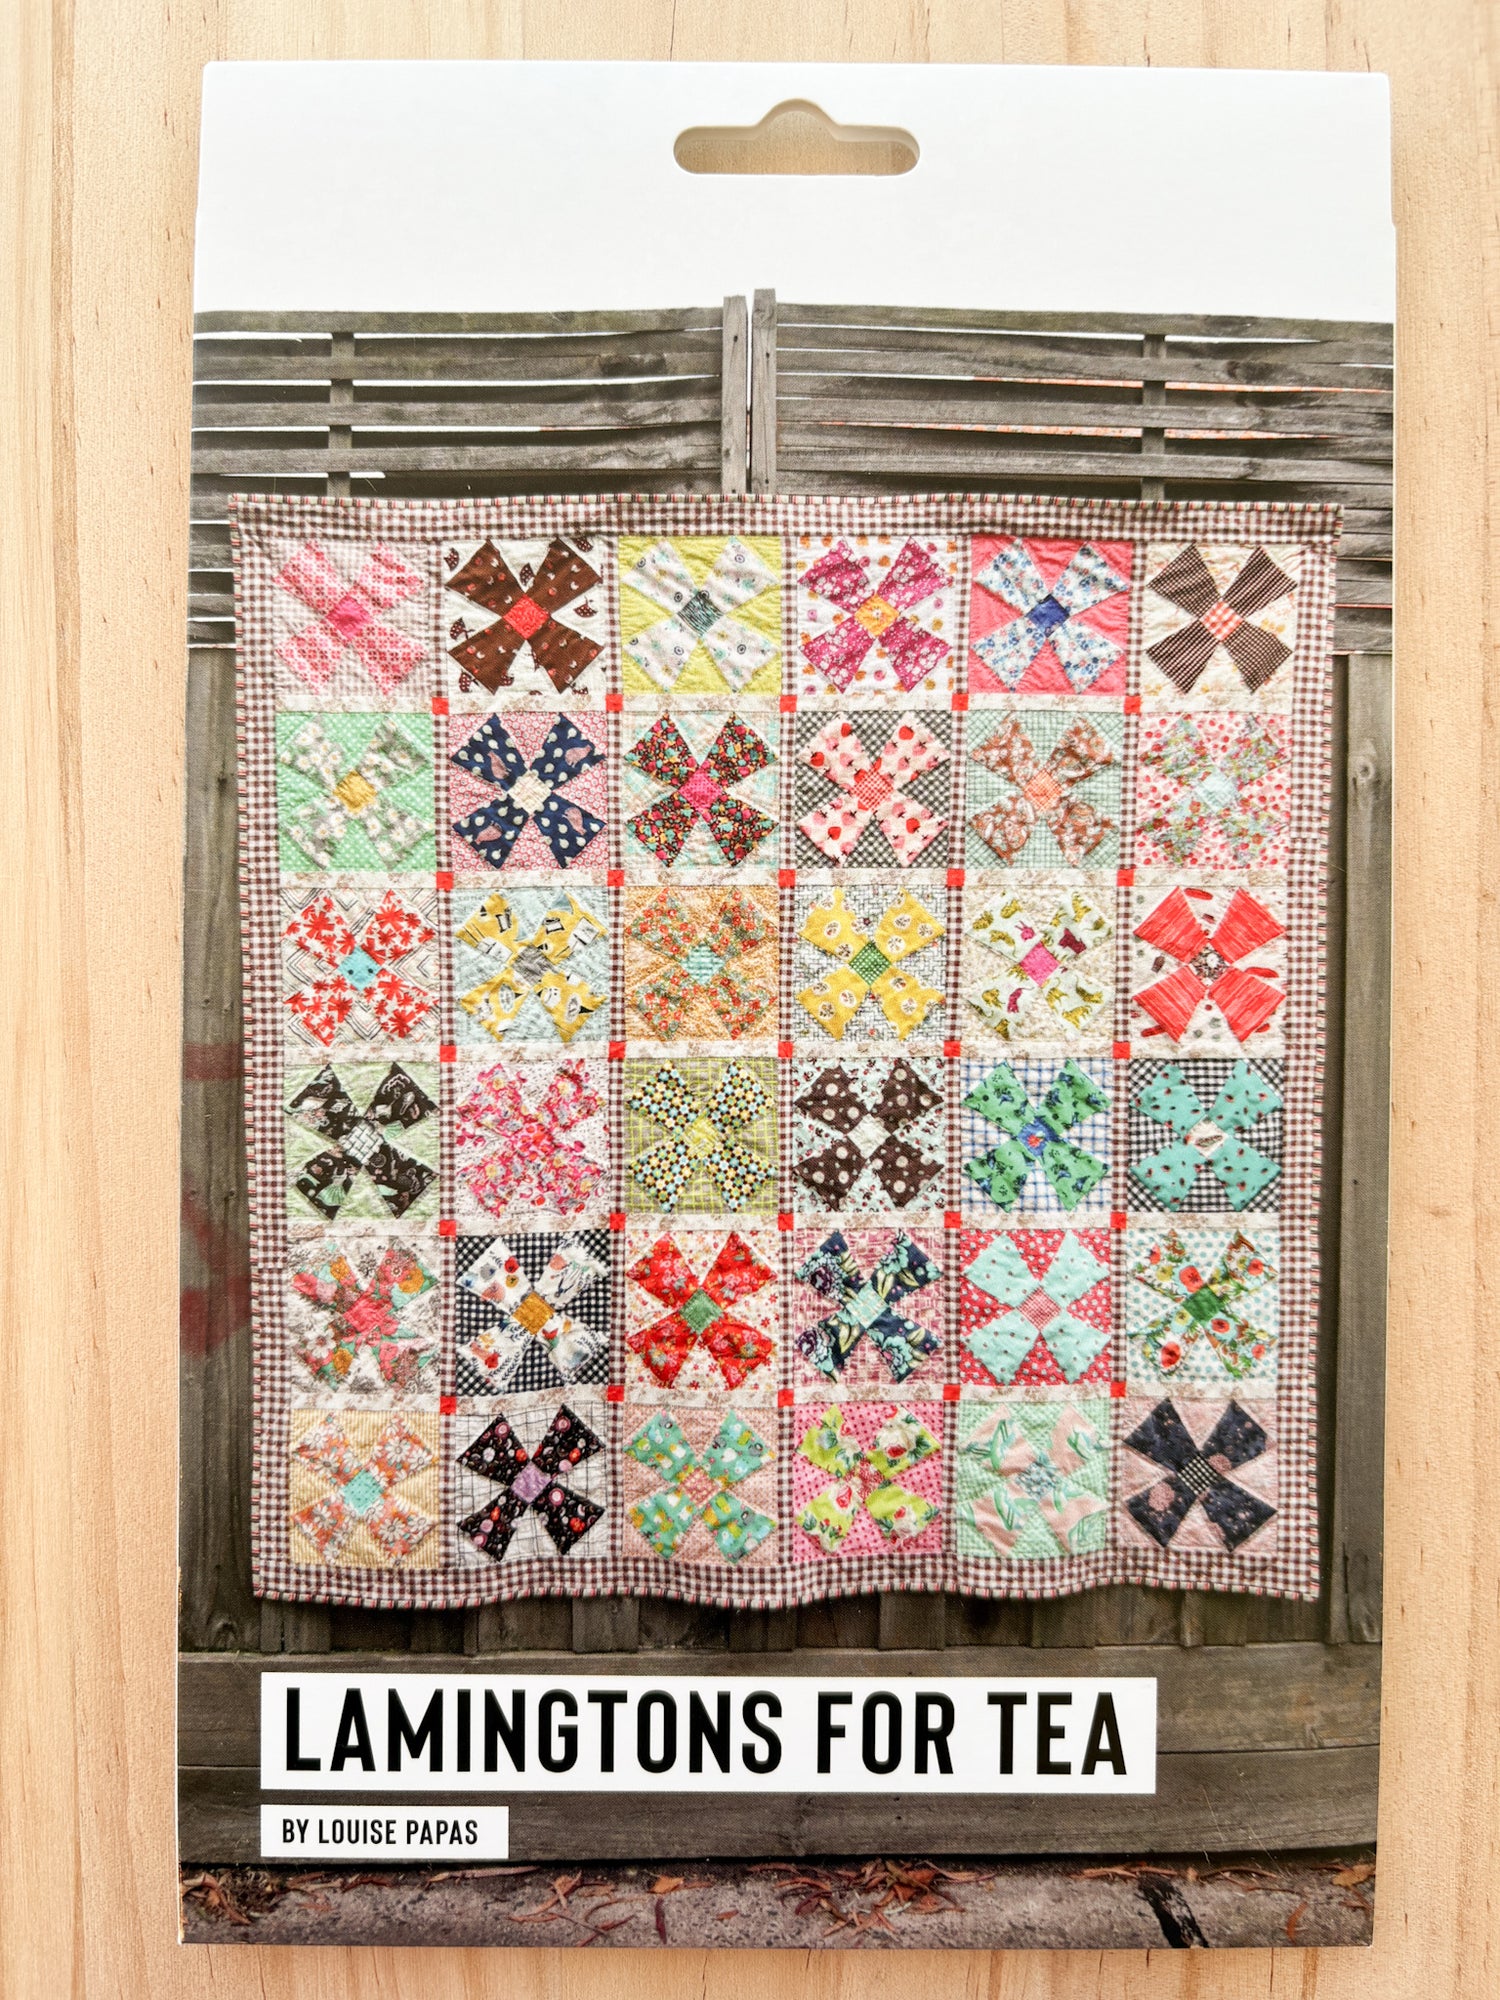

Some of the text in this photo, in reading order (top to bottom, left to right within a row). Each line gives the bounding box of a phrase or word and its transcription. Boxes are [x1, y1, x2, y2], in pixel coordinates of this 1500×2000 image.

[286, 1688, 1126, 1775] LAMINGTONS FOR TEA
[282, 1818, 477, 1844] BY LOUISE PAPAS
